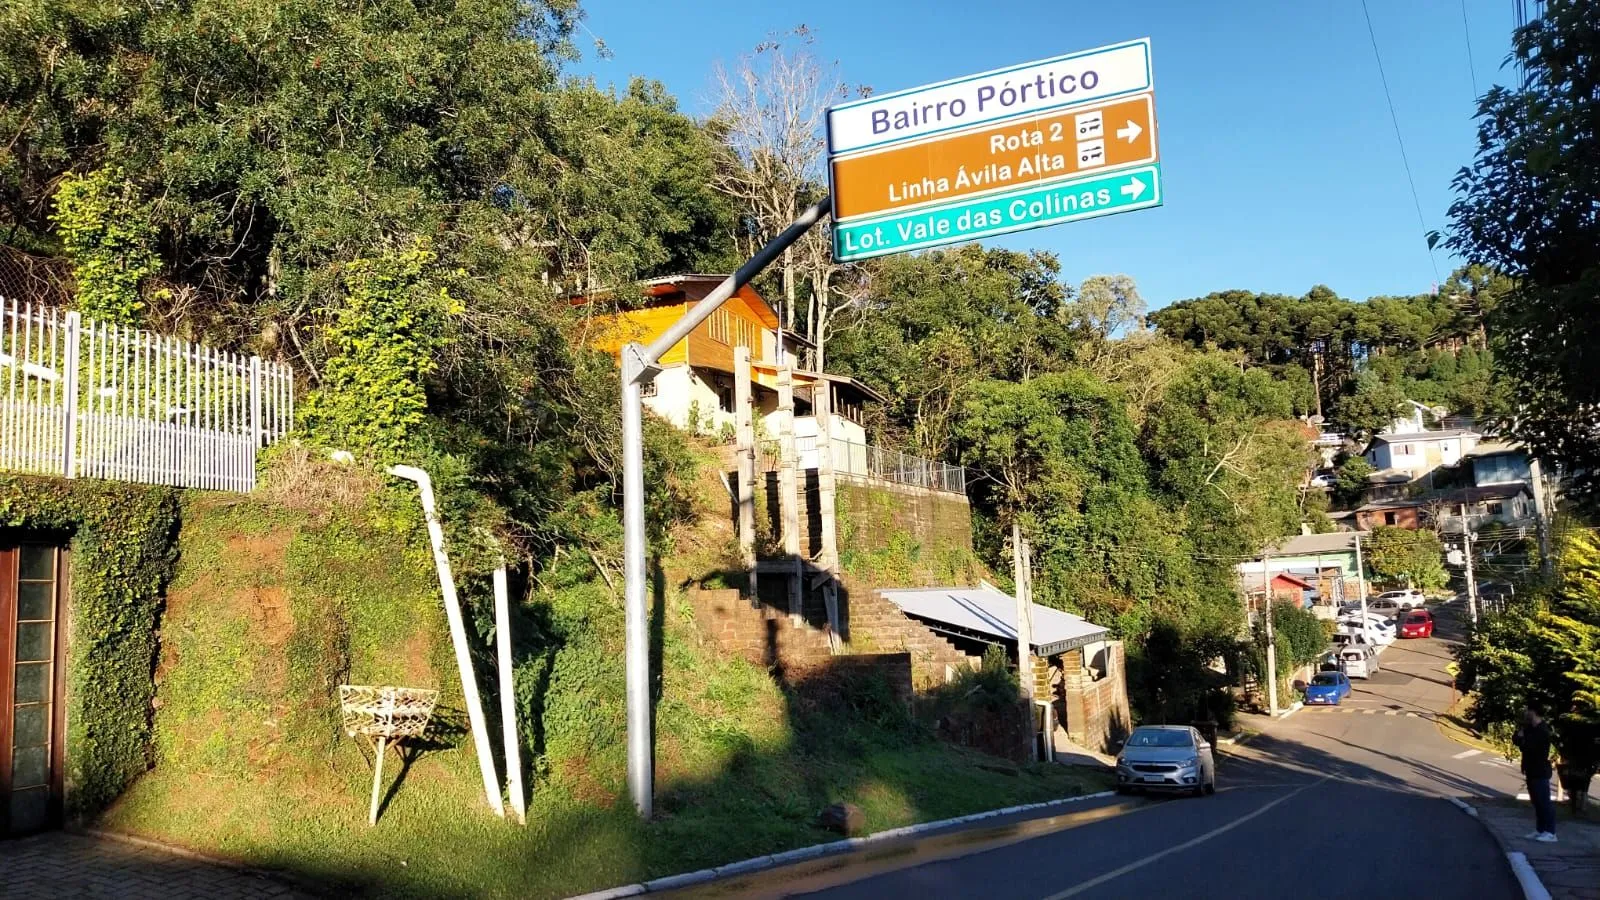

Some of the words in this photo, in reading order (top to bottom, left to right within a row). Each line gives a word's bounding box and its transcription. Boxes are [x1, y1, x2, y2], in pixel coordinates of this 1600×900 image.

[872, 98, 966, 135] Bairro
[977, 70, 1099, 112] Pórtico
[990, 126, 1043, 154] Rota
[1049, 123, 1064, 142] 2
[889, 175, 949, 202] Linha
[955, 163, 1011, 190] Ávila
[1018, 152, 1065, 174] Alta
[845, 226, 890, 251] Lot.
[897, 212, 950, 242] Vale
[957, 206, 1002, 232] das
[1009, 186, 1111, 222] Colinas
